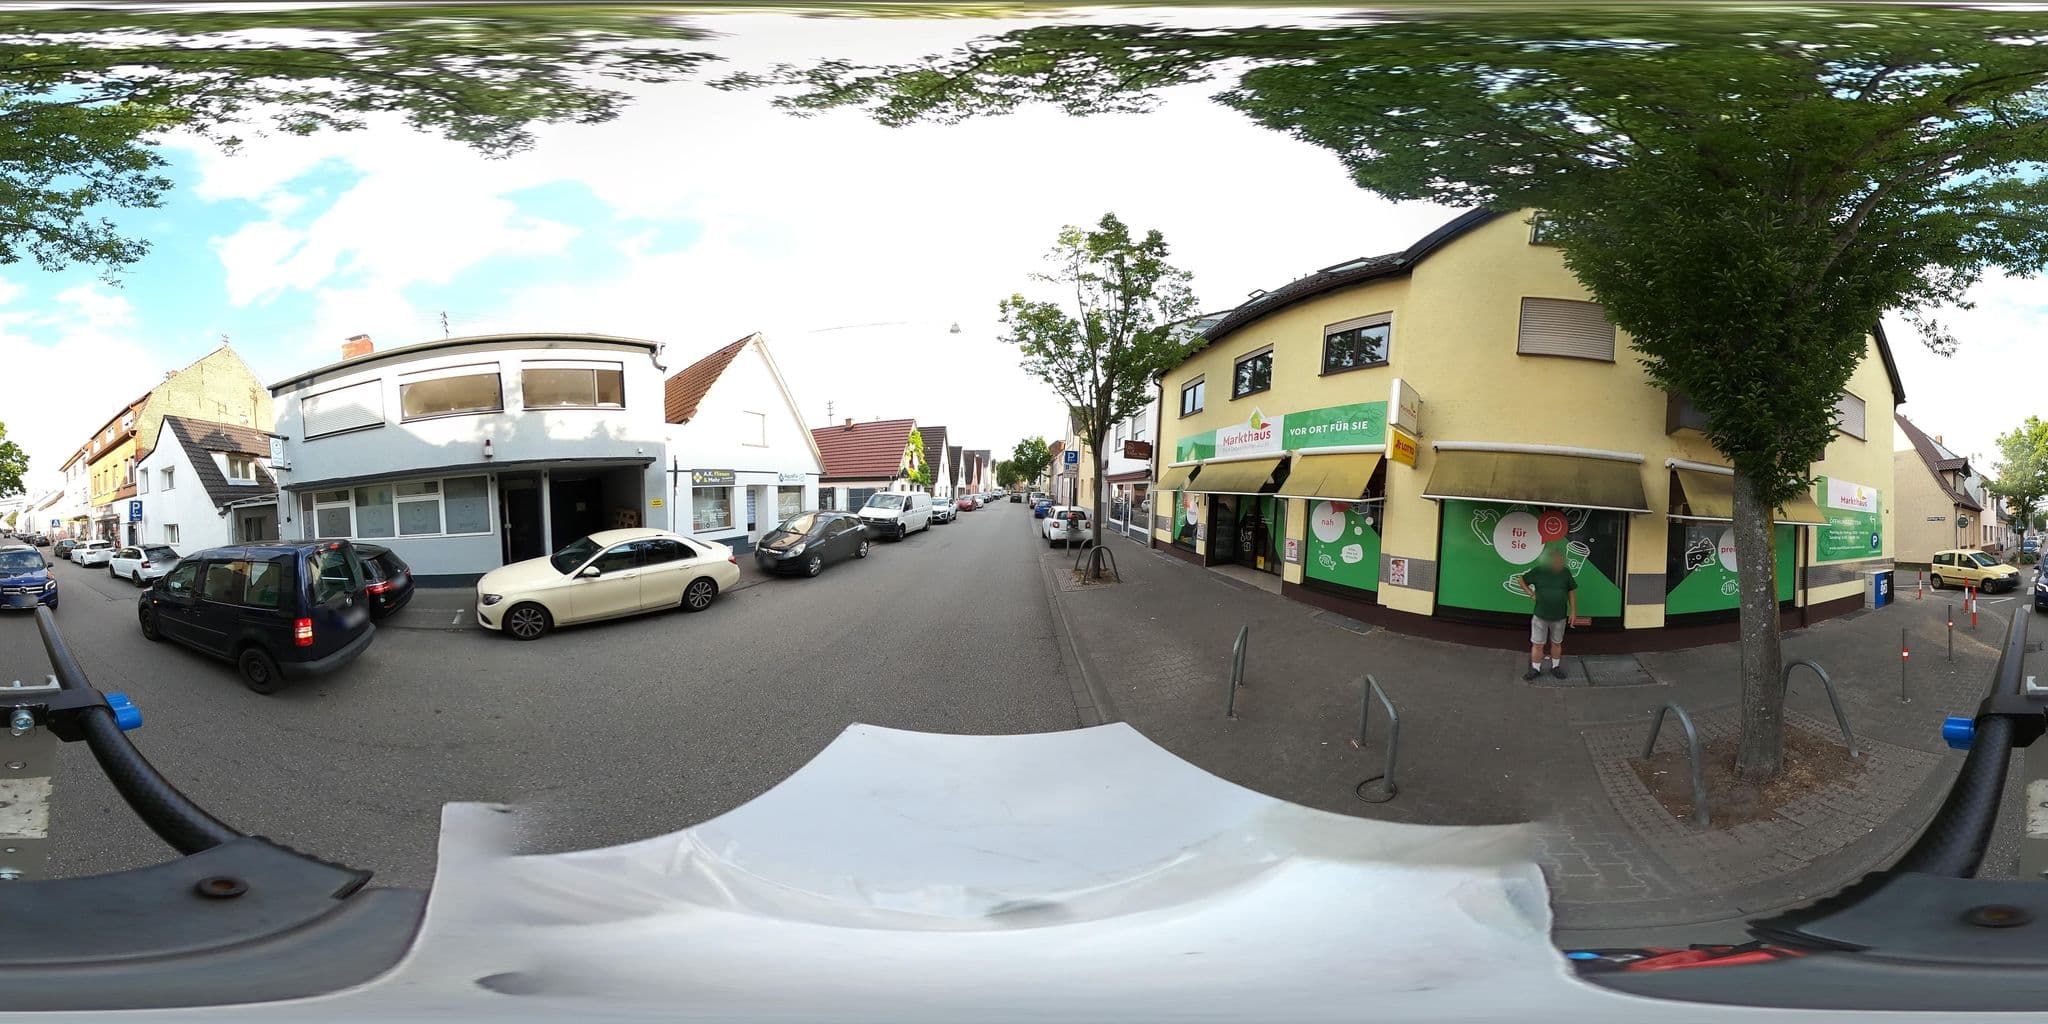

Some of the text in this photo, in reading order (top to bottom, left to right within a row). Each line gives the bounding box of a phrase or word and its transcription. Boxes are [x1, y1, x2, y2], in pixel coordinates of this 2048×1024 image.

[1289, 420, 1368, 437] VOR ORT FÜR SIE
[1223, 430, 1271, 446] Markthaus
[1321, 518, 1334, 526] nah
[1512, 527, 1527, 537] für
[1511, 540, 1527, 550] Sie
